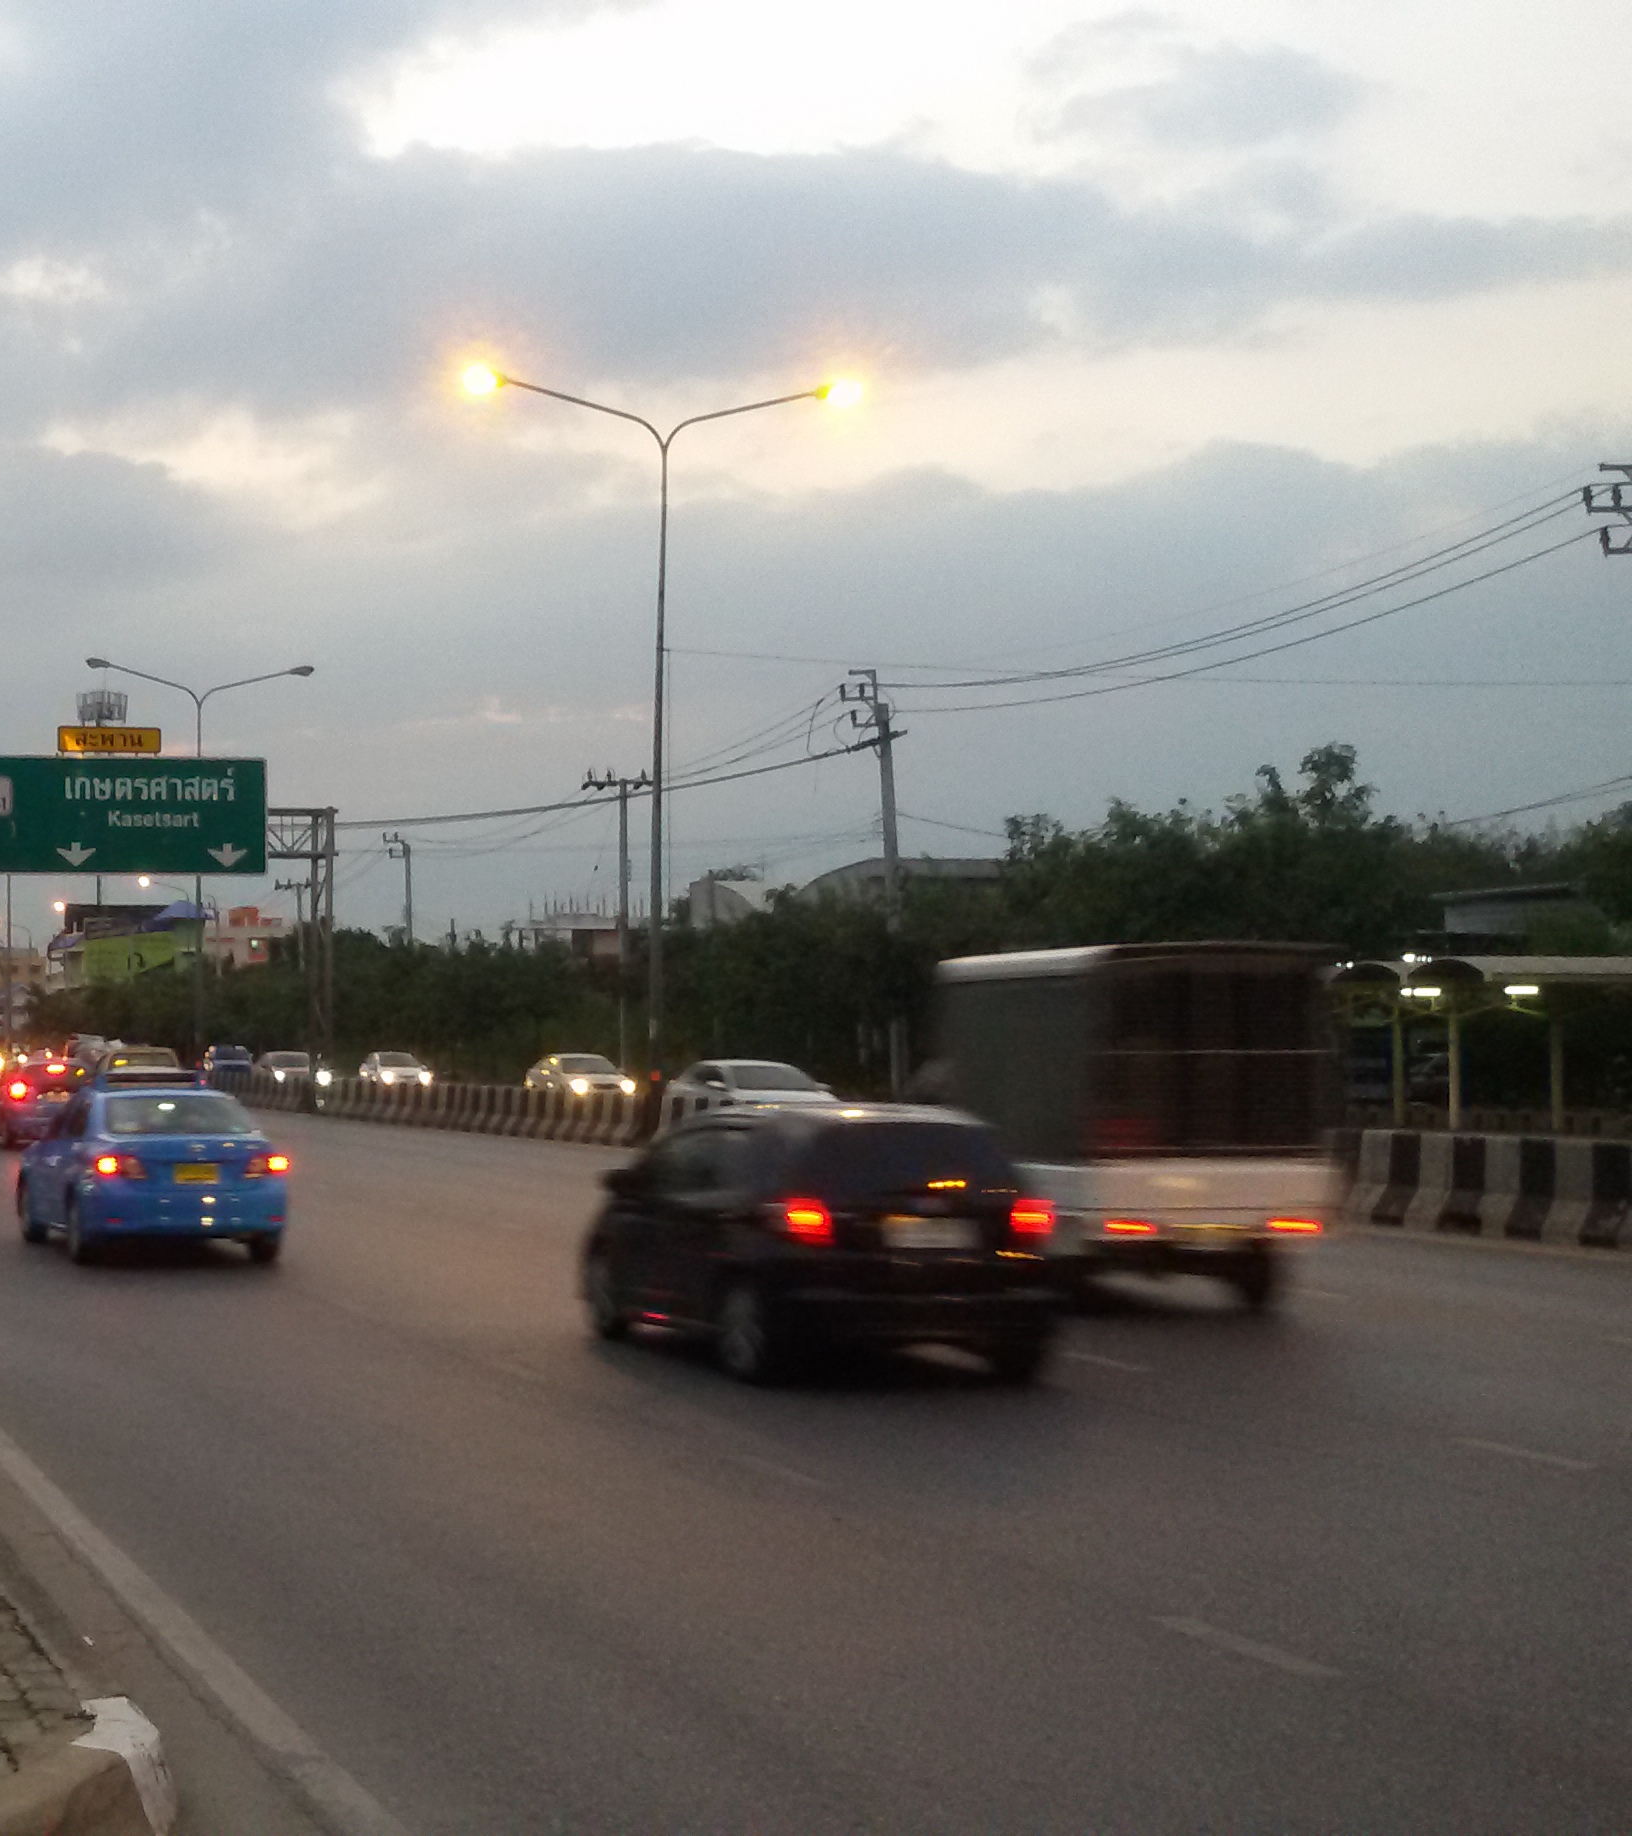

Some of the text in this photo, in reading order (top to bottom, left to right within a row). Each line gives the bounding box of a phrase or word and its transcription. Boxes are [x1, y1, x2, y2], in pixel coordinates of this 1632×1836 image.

[74, 730, 145, 749] สะพาน
[64, 767, 236, 801] เกษตรศาสตร์
[107, 810, 200, 829] Kasetsart
